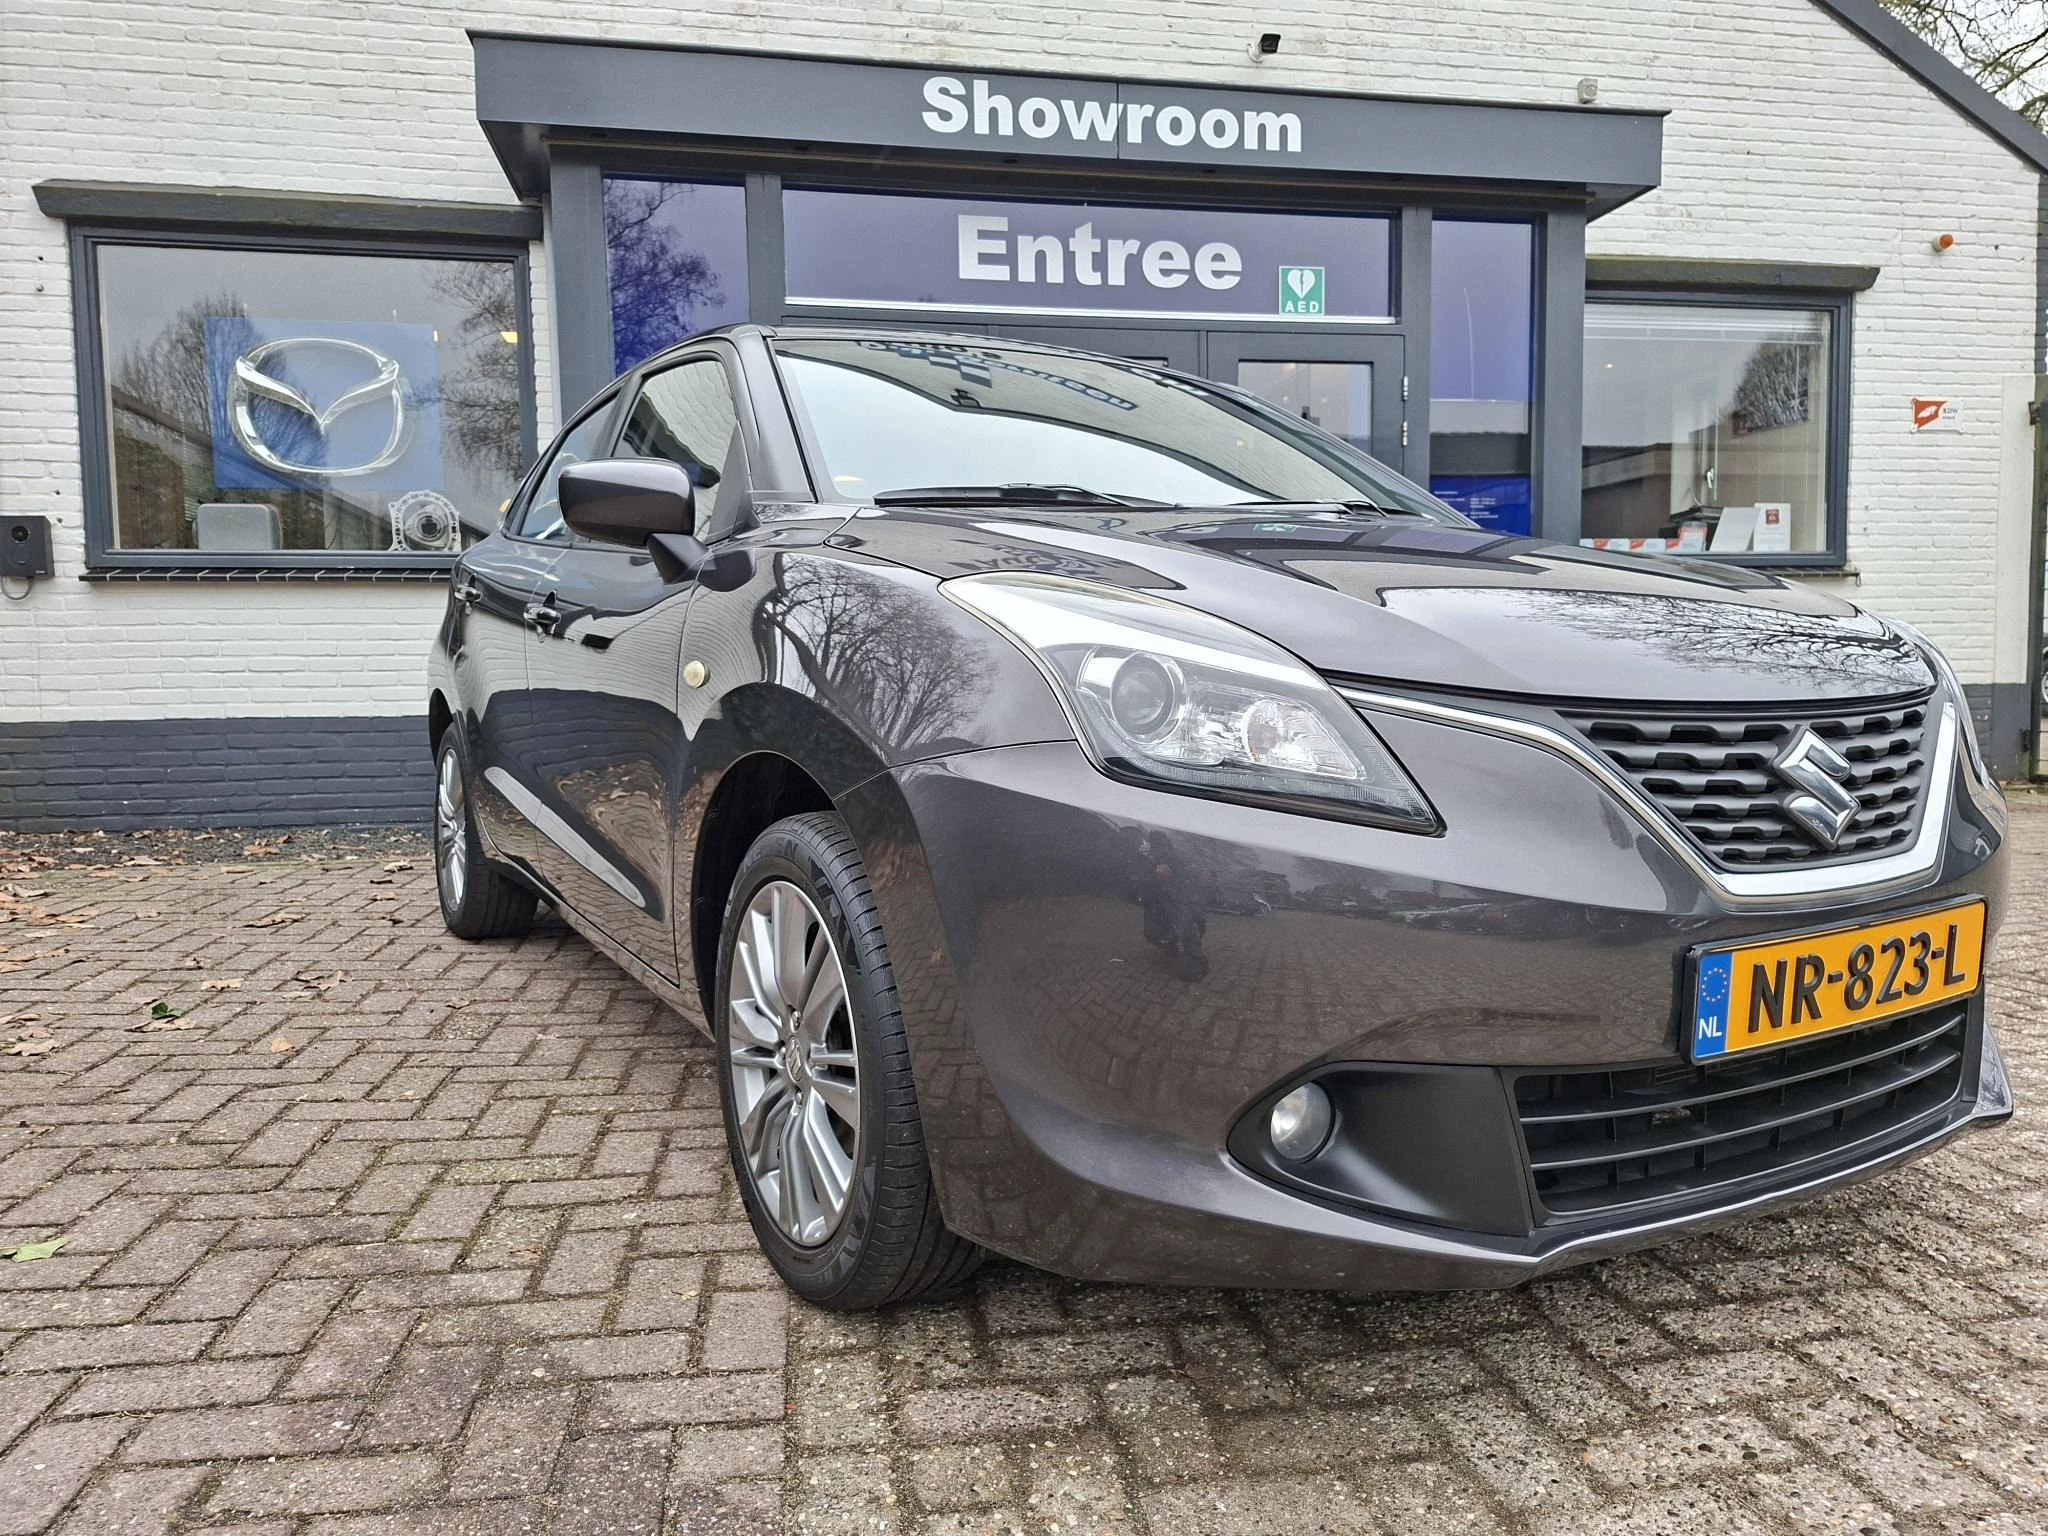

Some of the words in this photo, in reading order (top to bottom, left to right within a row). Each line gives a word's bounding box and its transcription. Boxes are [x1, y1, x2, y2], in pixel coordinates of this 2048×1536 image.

[922, 76, 1302, 152] Showroom
[958, 216, 1241, 289] Entree
[1285, 301, 1319, 313] AED
[1748, 924, 1965, 1032] NR-823-L
[1698, 1016, 1722, 1040] NL
